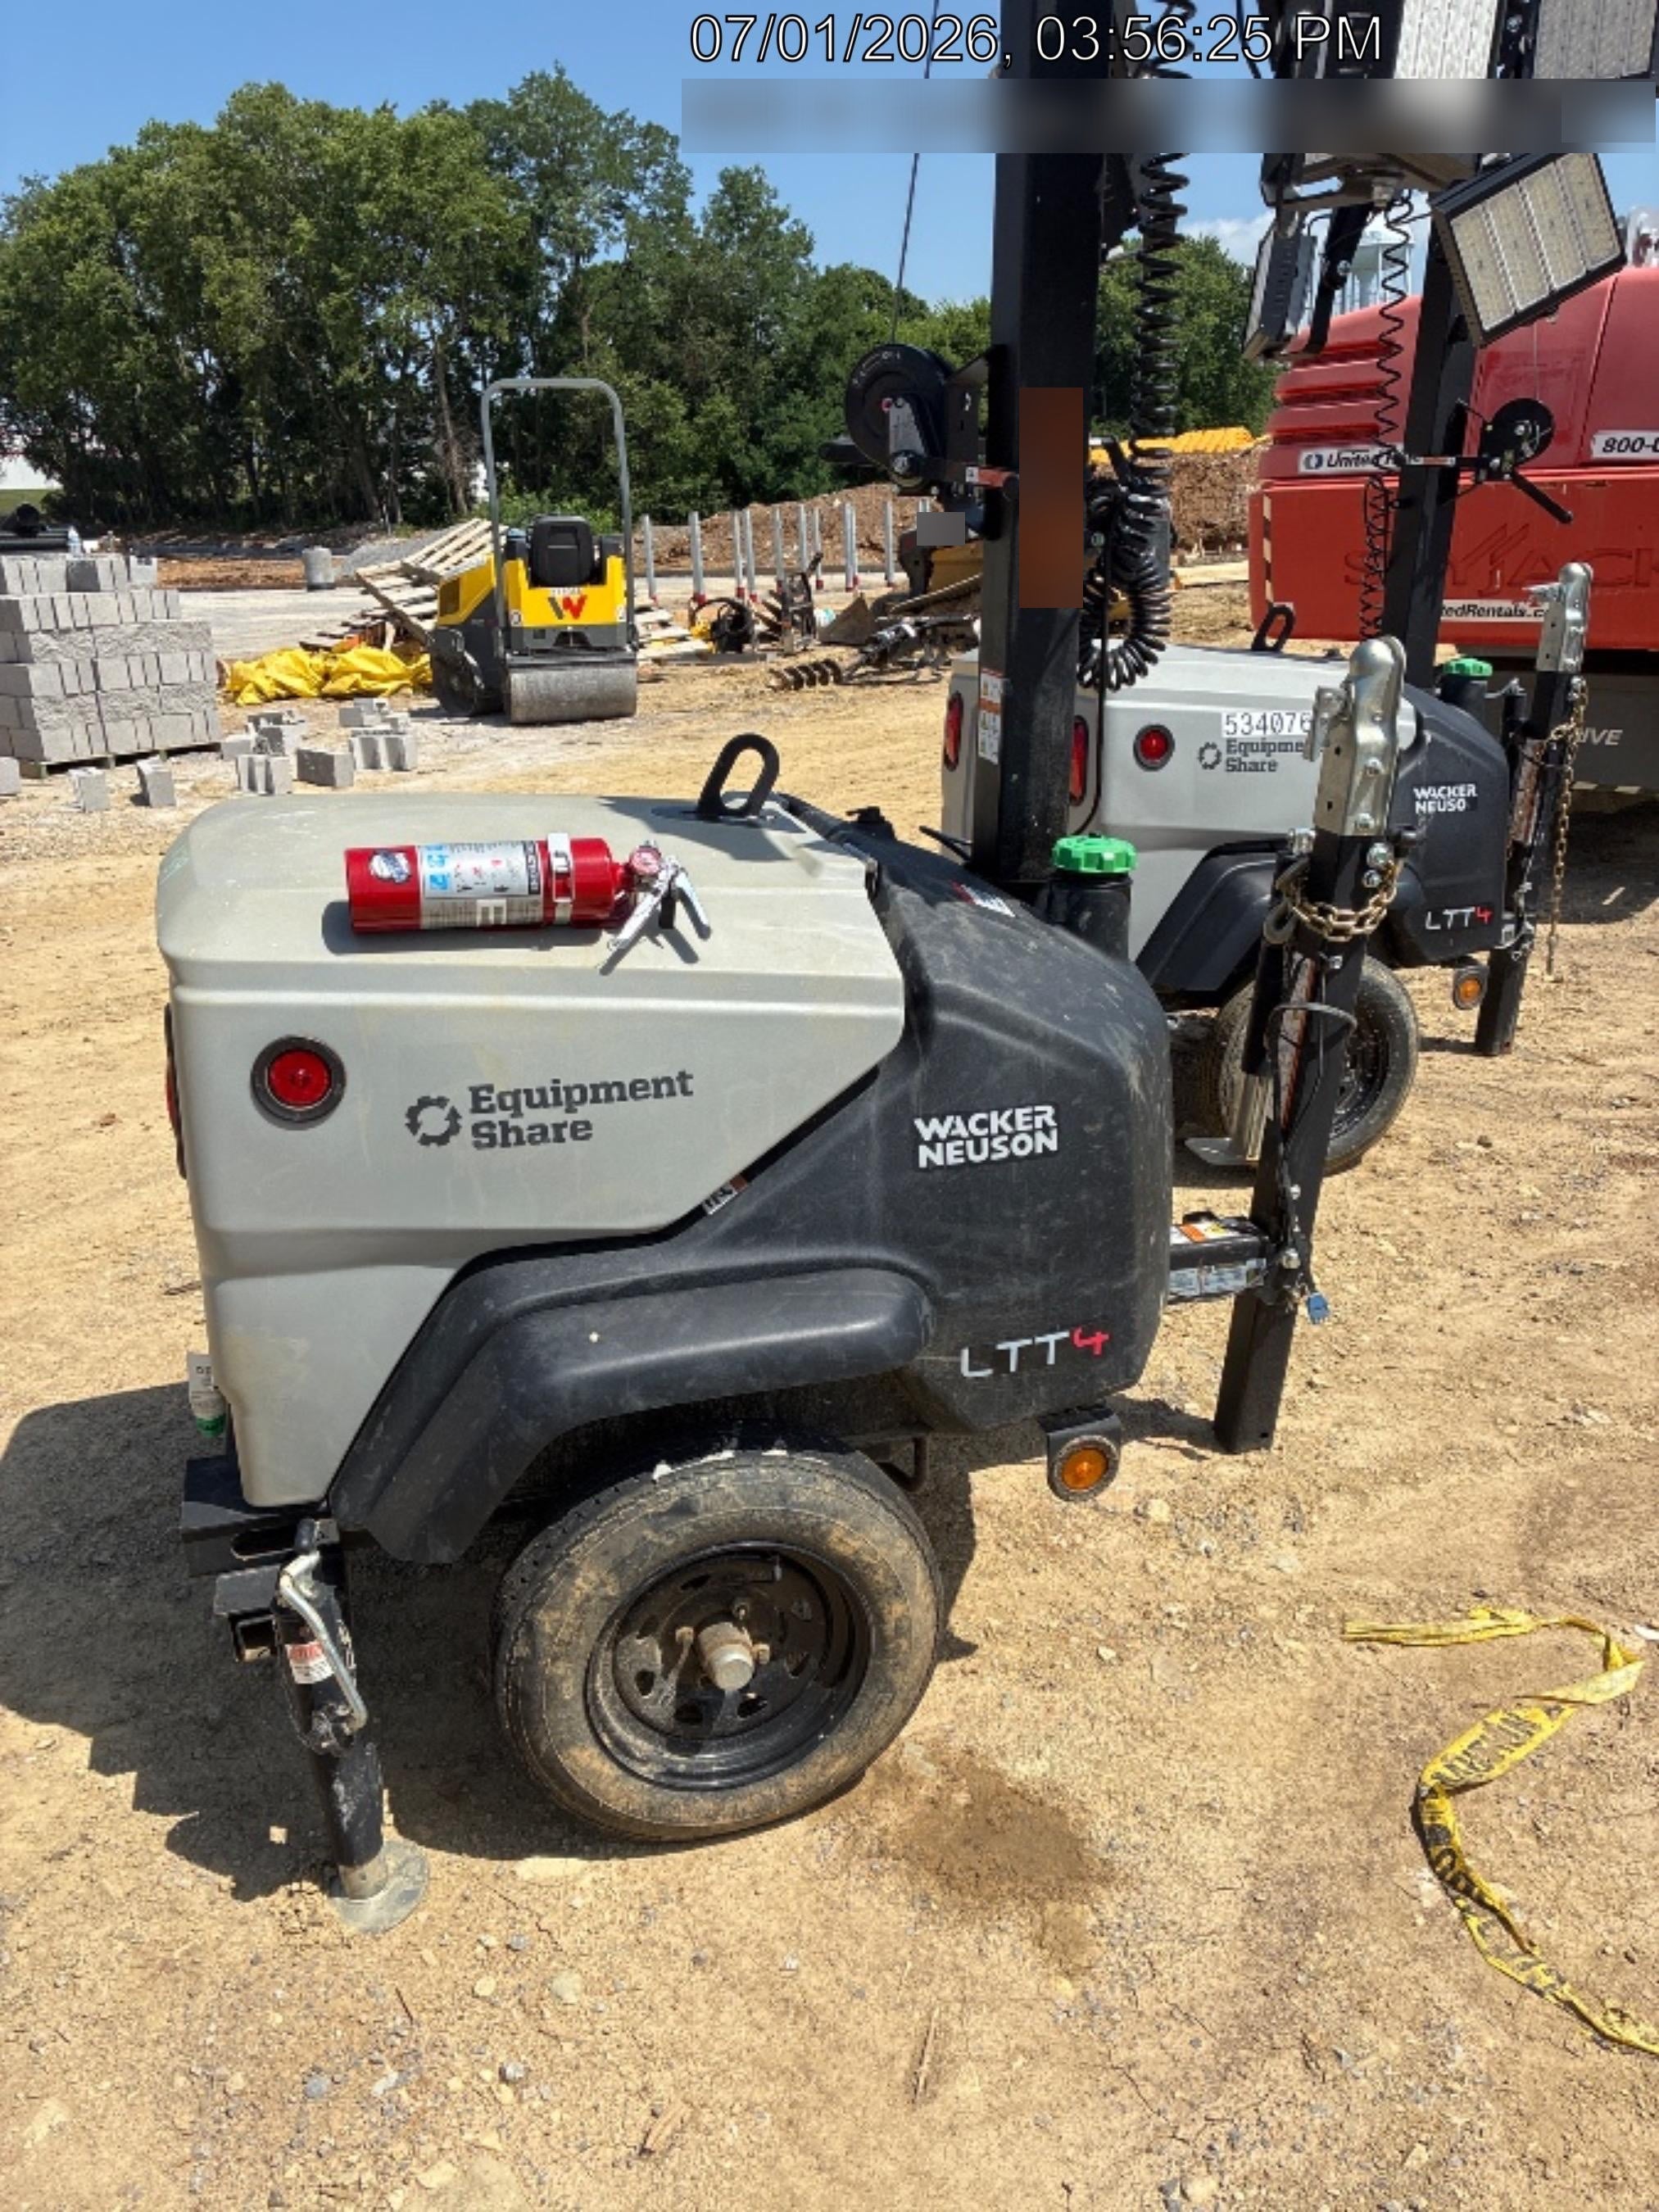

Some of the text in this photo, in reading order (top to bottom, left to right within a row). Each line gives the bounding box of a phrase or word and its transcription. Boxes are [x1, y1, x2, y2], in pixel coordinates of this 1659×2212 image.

[1226, 712, 1312, 735] 534076
[1226, 738, 1304, 757] Equipme
[1226, 757, 1279, 772] Share
[1413, 783, 1478, 800] WACKER
[469, 1070, 693, 1114] Equipment
[471, 1119, 593, 1150] Share
[913, 1105, 1057, 1140] WACKER
[918, 1128, 1058, 1168] NEUSON
[960, 1326, 1109, 1377] LTT4
